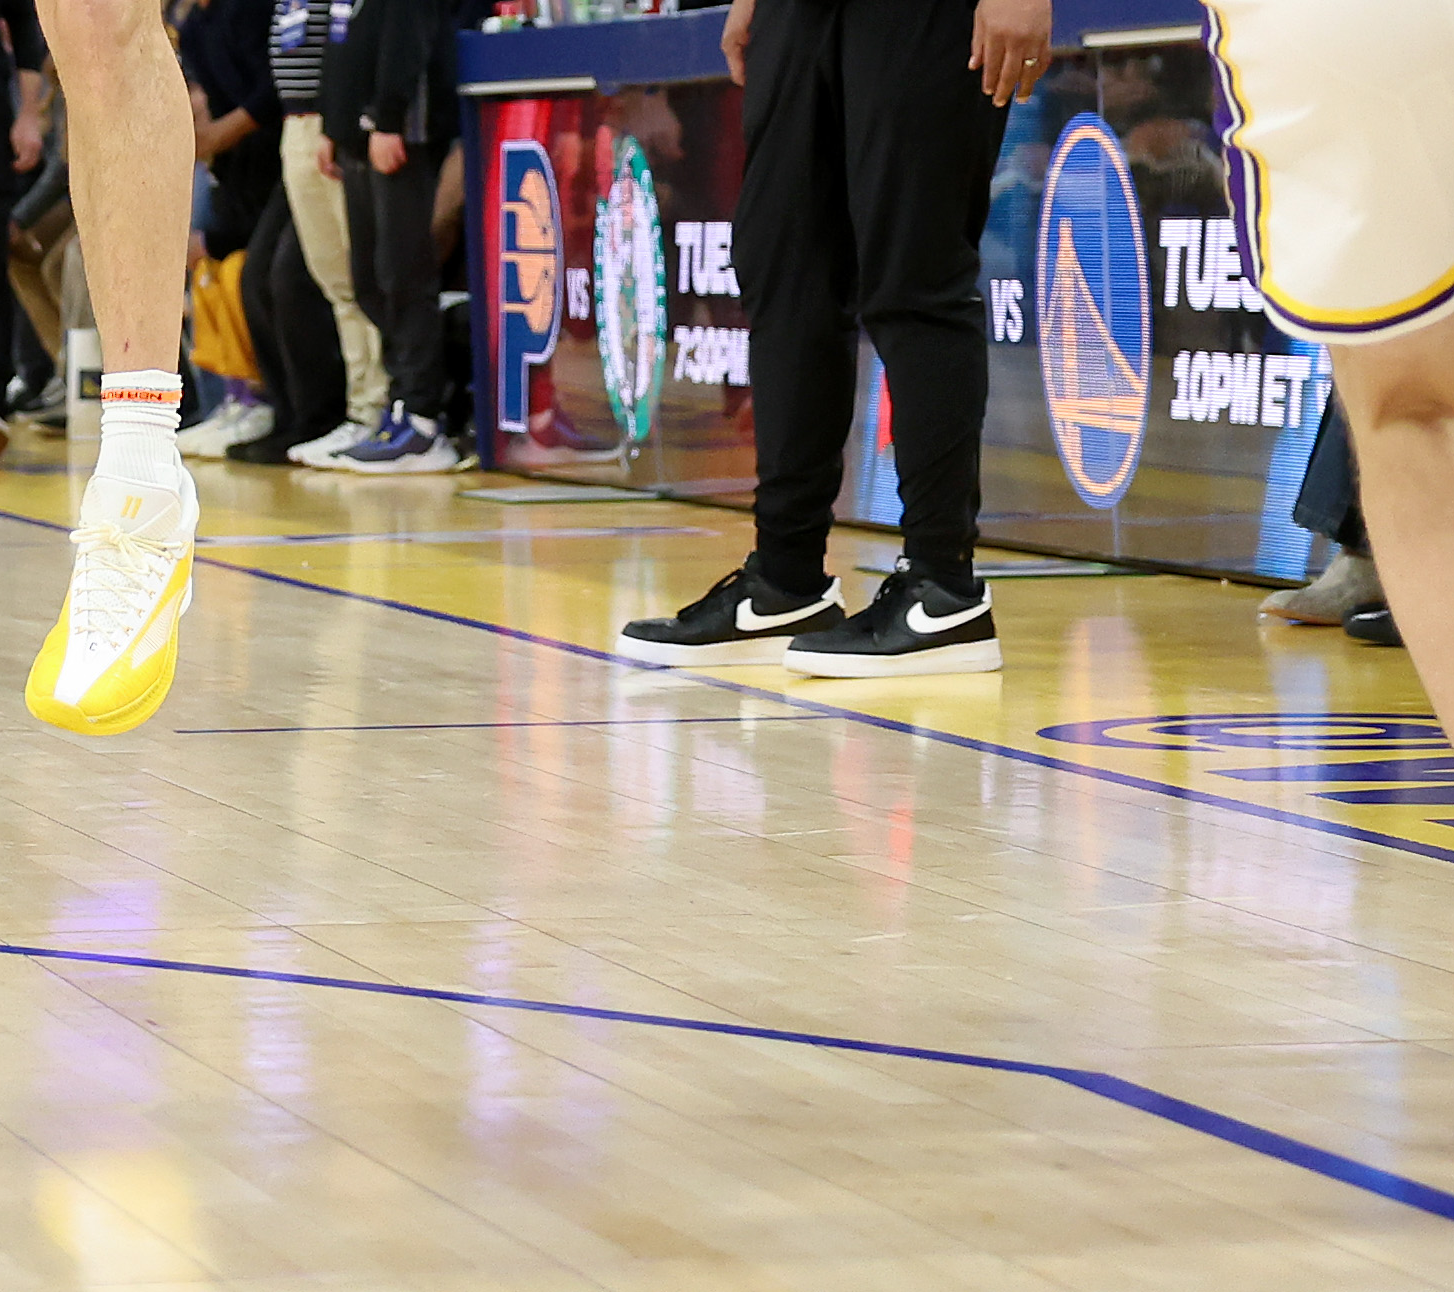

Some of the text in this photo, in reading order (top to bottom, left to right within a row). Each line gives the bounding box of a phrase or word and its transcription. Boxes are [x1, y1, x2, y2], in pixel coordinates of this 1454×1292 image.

[565, 266, 591, 321] VS
[989, 278, 1025, 344] VS
[1169, 349, 1262, 428] 10PM
[1260, 353, 1313, 429] ET
